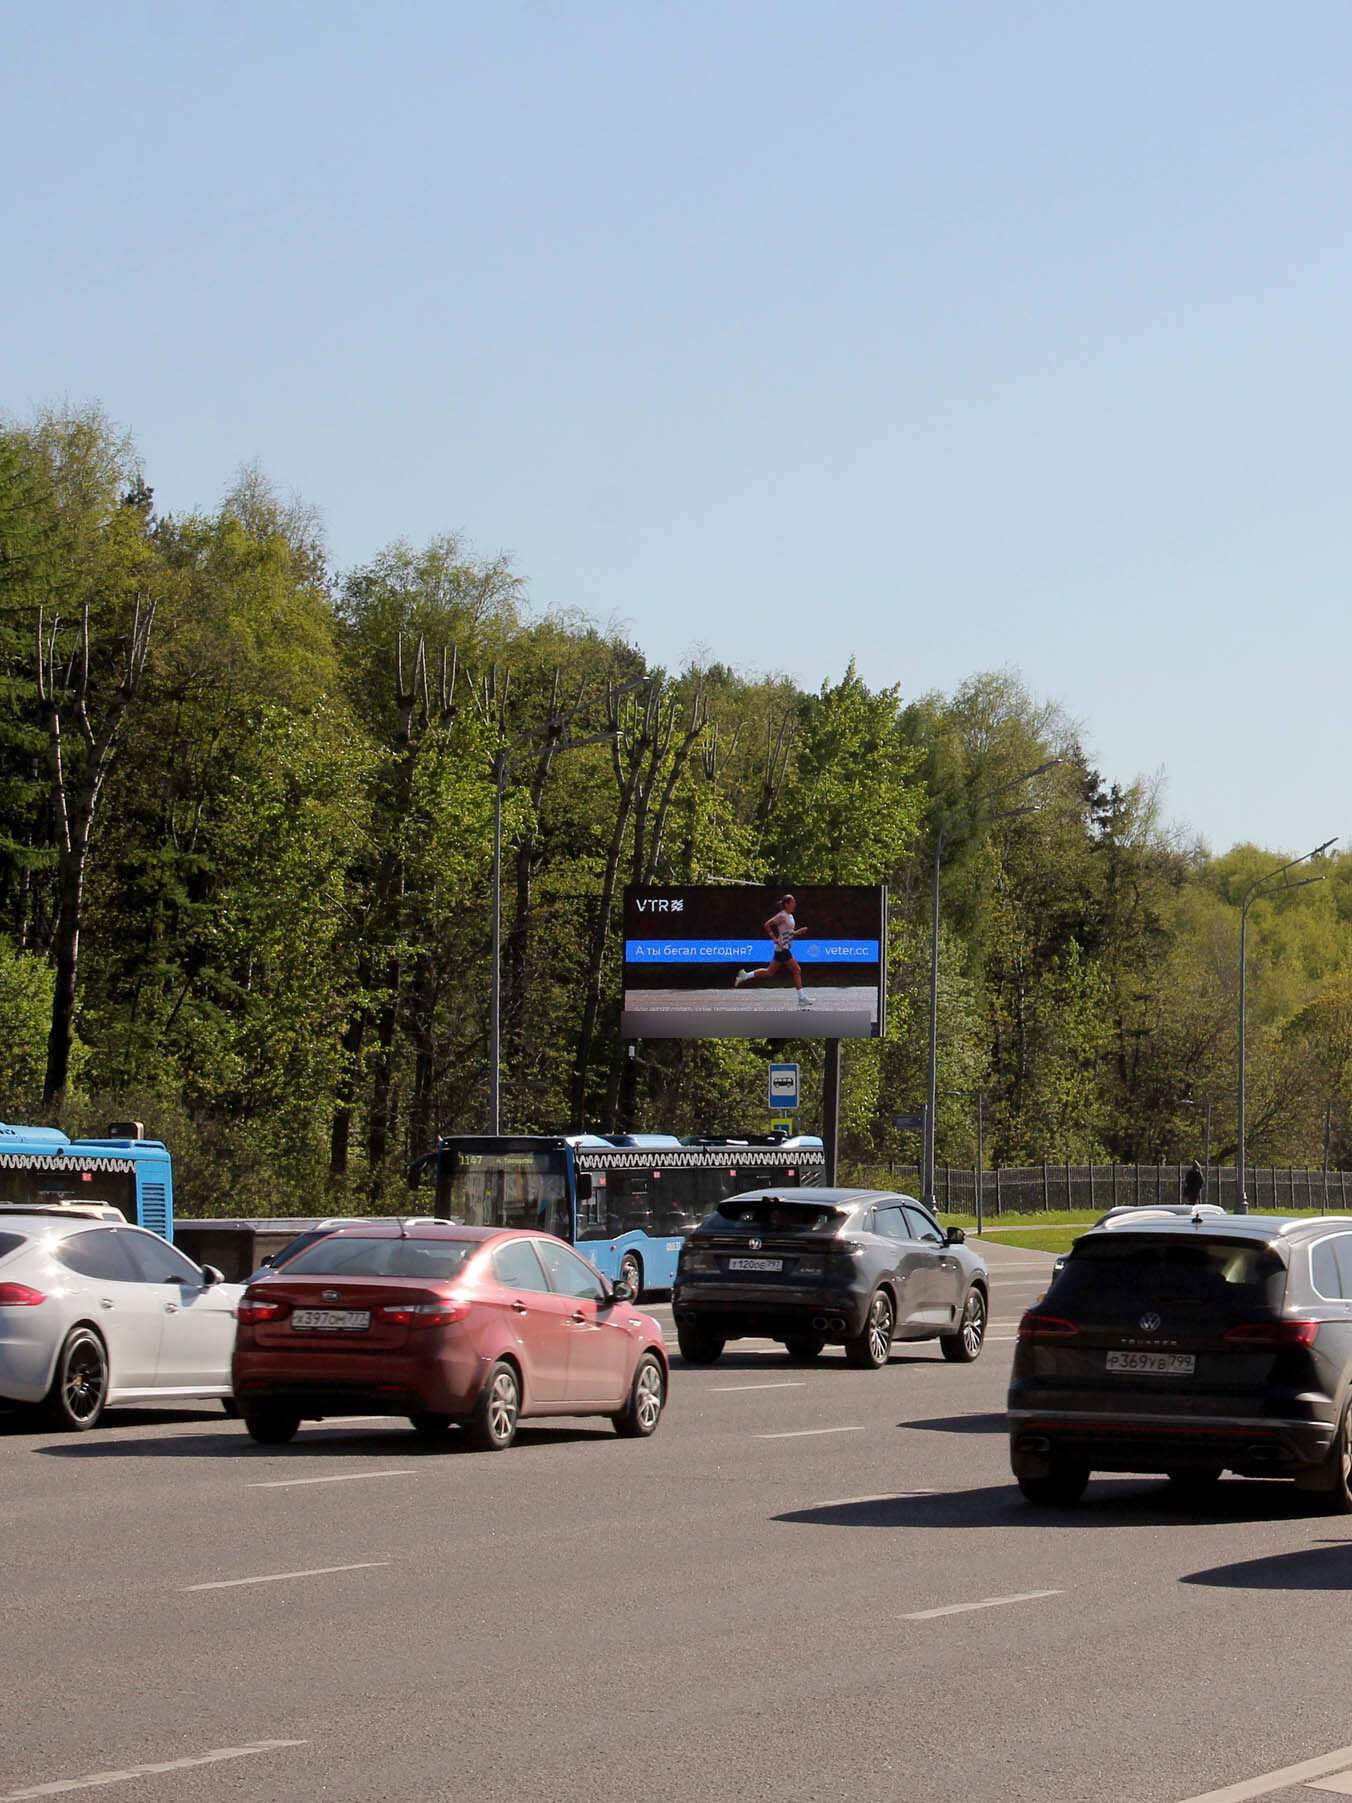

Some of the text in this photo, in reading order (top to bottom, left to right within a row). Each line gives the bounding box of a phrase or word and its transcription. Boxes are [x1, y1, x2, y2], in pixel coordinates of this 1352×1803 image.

[636, 899, 669, 912] VTR
[635, 946, 645, 956] А
[663, 945, 697, 956] бегал
[699, 945, 753, 958] сегодня?
[825, 945, 869, 956] veter.cc
